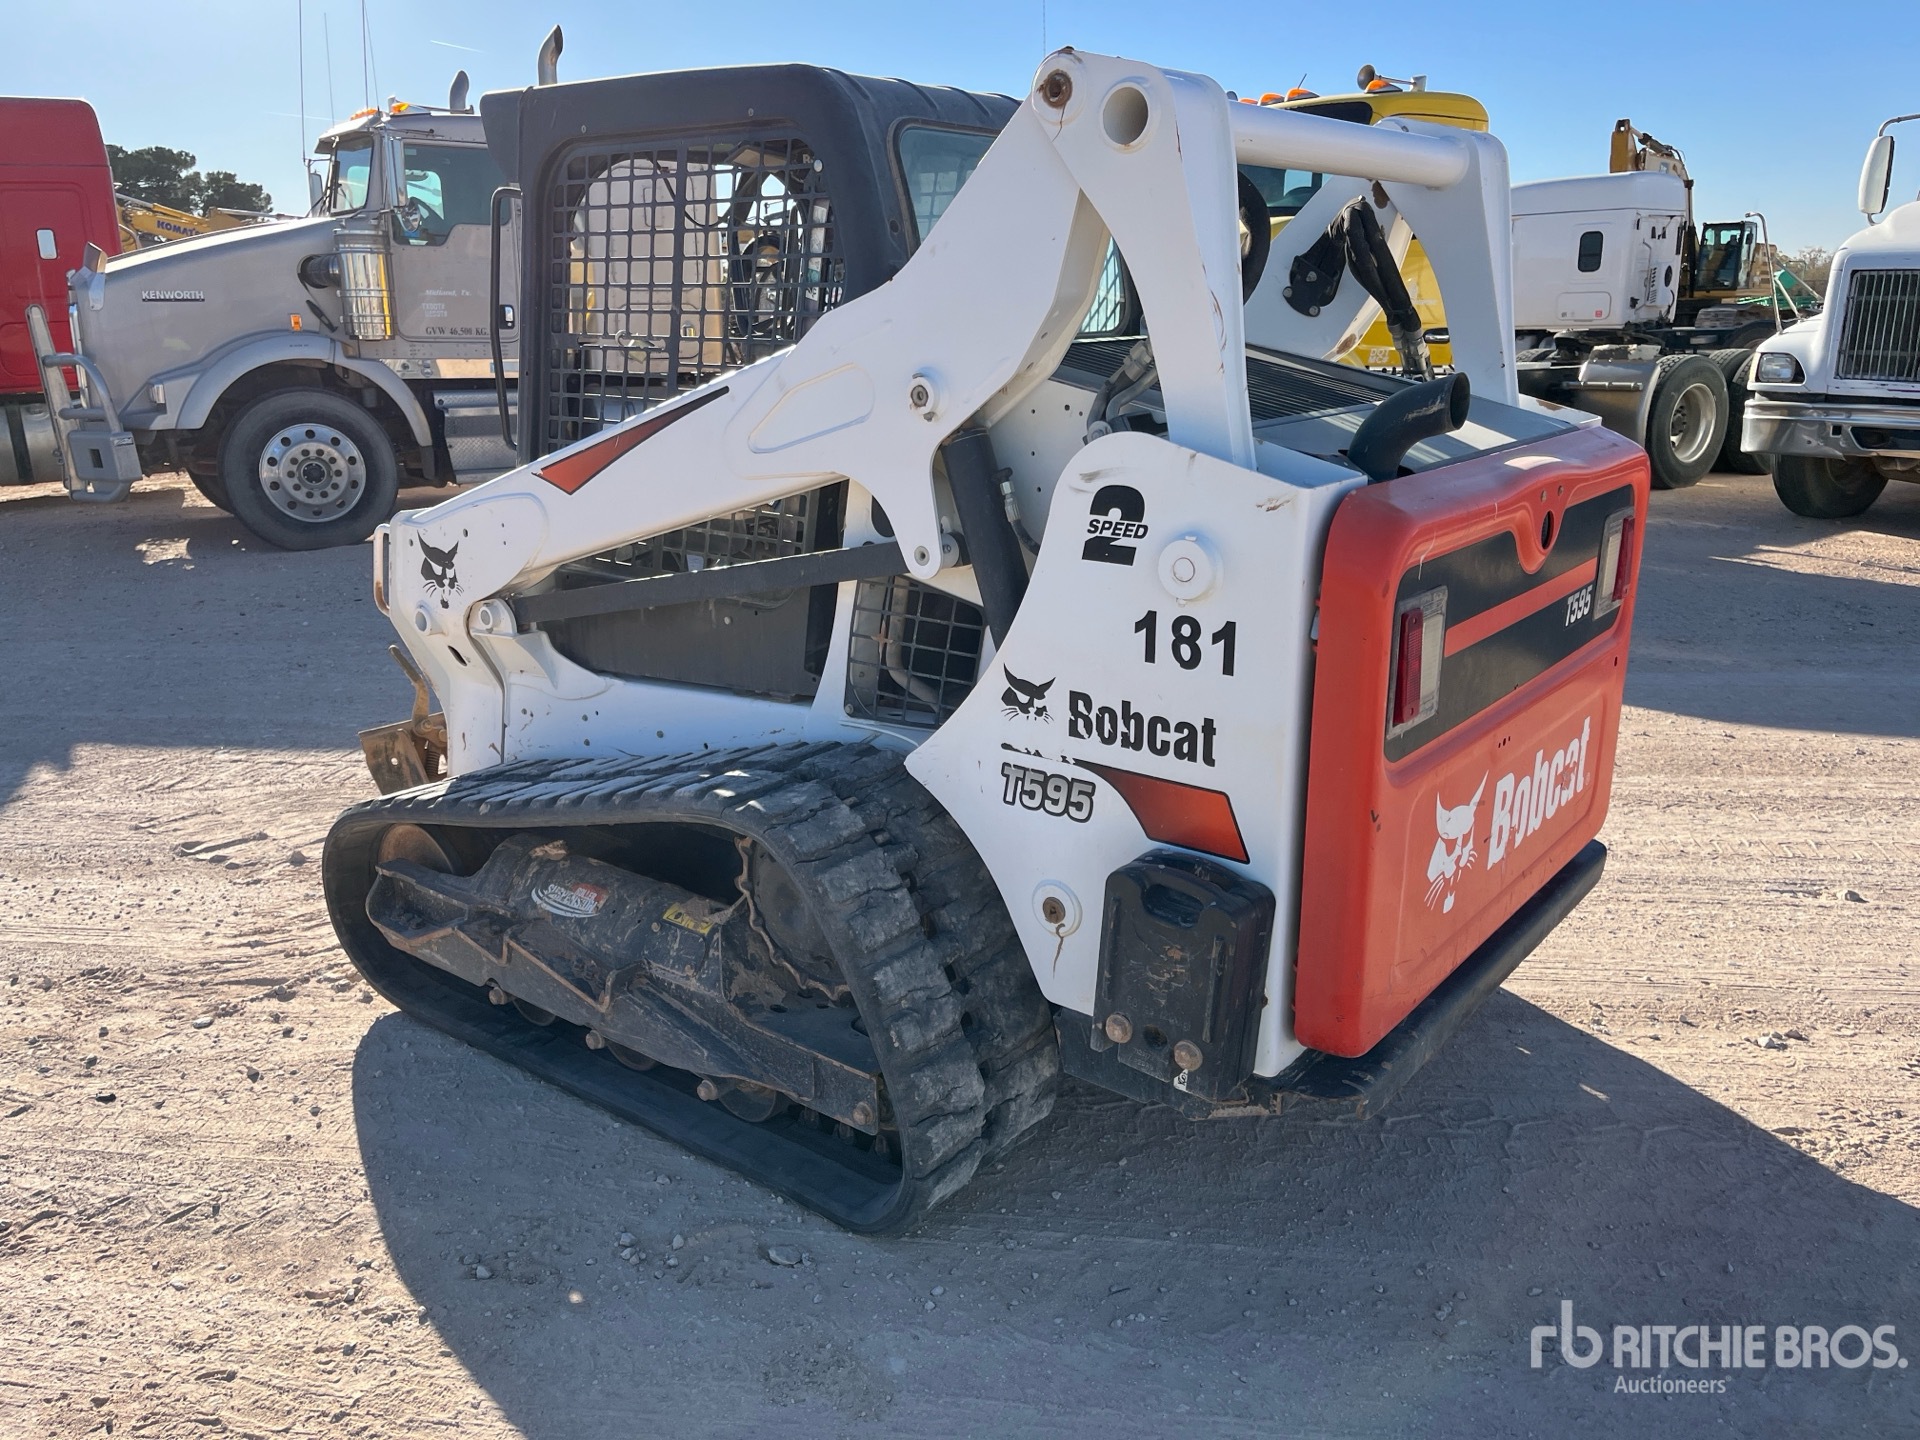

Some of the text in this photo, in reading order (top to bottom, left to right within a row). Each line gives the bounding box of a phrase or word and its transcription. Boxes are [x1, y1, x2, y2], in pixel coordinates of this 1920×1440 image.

[157, 220, 200, 236] KOMAT
[142, 290, 204, 299] KENWORTH
[425, 327, 446, 335] GVW
[1082, 485, 1145, 566] 2
[1086, 518, 1149, 540] SPEED
[1565, 584, 1592, 627] T595
[1134, 610, 1237, 677] 181
[1068, 690, 1216, 768] Bobcat
[1001, 762, 1096, 824] T595
[1487, 716, 1591, 870] Bobcat
